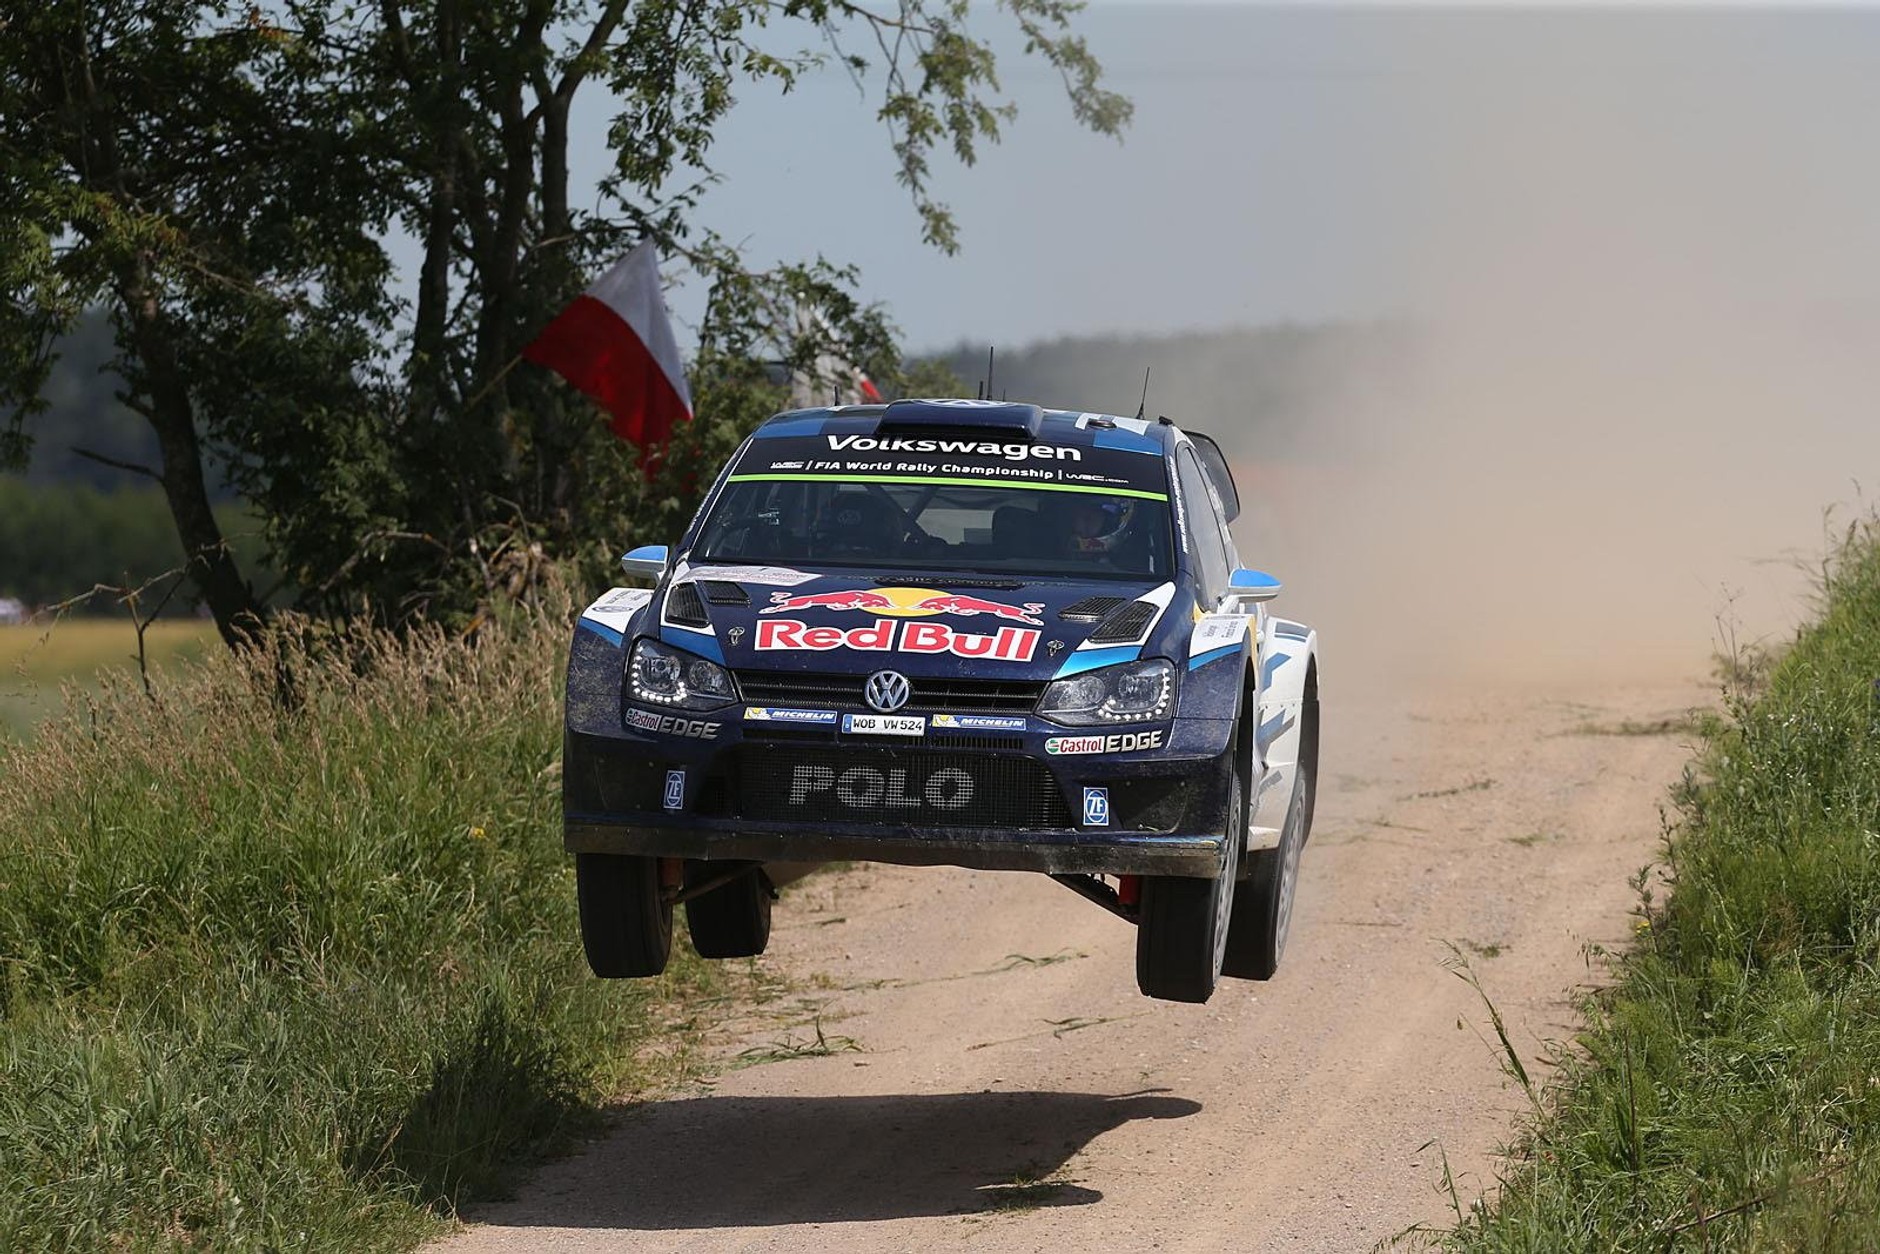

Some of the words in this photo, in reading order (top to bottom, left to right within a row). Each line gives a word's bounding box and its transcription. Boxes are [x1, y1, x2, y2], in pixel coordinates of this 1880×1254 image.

[827, 434, 1082, 461] Volkswagen
[814, 461, 841, 470] FIA
[846, 462, 891, 471] World
[896, 462, 937, 474] Rally
[941, 464, 1054, 479] Championship
[756, 620, 896, 650] Red
[901, 621, 1039, 660] Bull
[632, 711, 659, 730] Castrol
[658, 716, 722, 740] EDGE
[772, 711, 835, 720] MICHELIN
[853, 718, 876, 729] WOB
[960, 717, 1024, 727] MICHELIN
[1059, 737, 1103, 754] Castrol
[1104, 730, 1163, 754] EDGE
[789, 765, 975, 811] POLO
